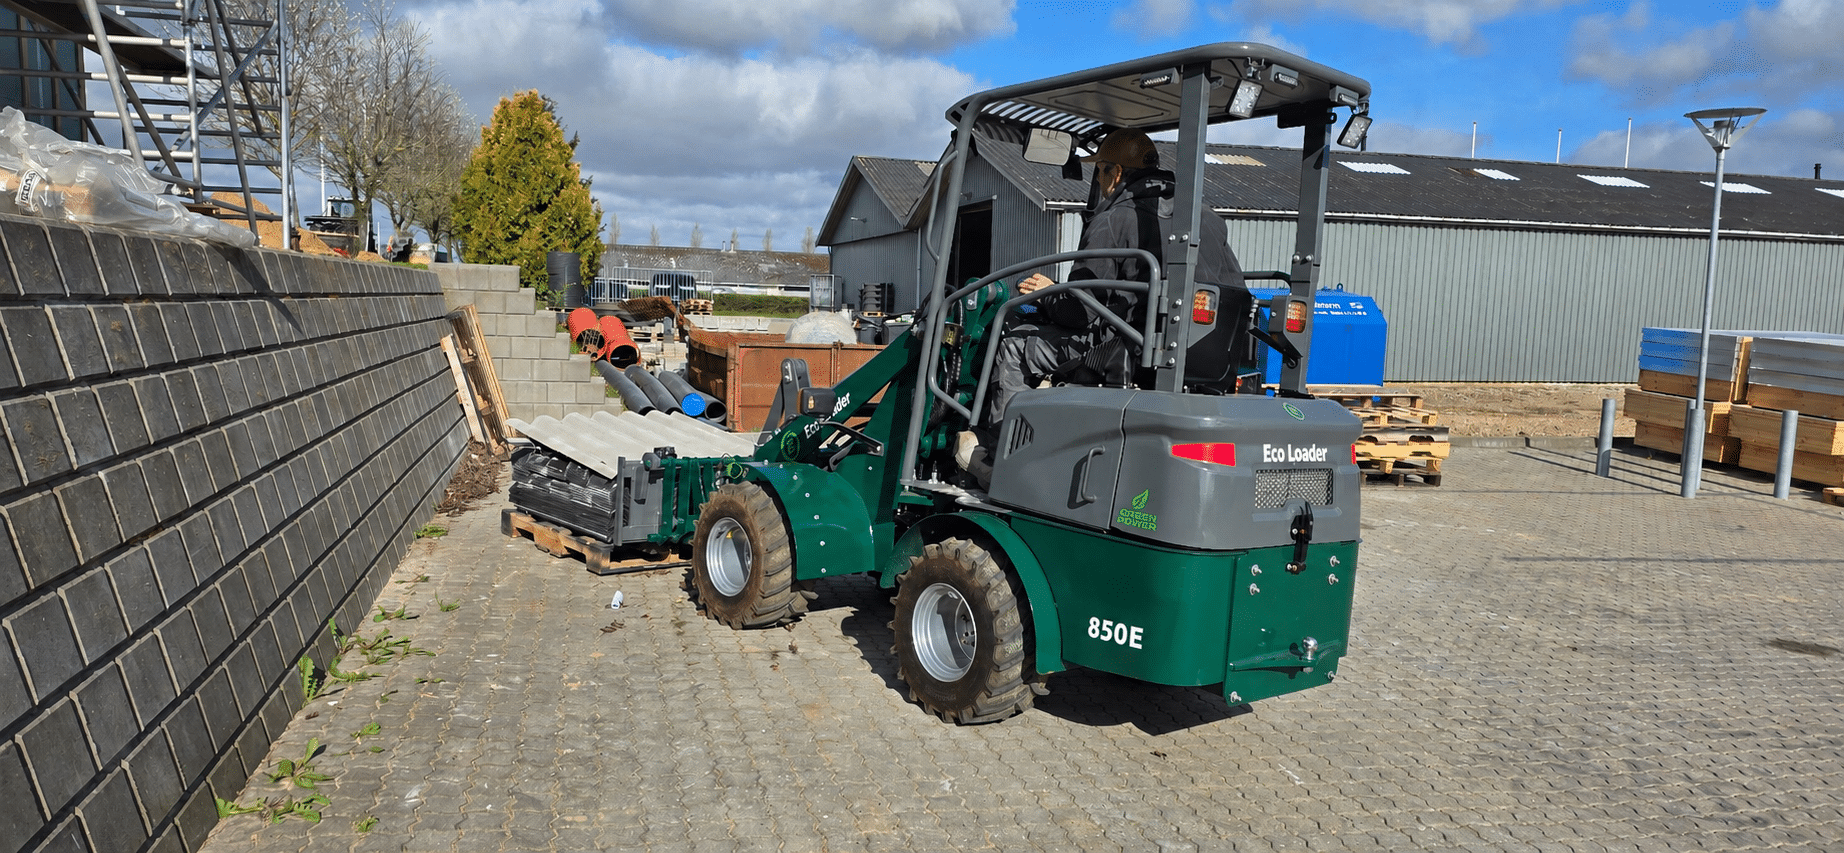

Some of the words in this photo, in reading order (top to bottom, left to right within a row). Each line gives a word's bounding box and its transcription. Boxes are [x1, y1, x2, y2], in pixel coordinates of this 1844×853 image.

[804, 421, 820, 439] Eco
[1263, 444, 1285, 463] Eco
[1287, 444, 1328, 463] Loader
[1116, 516, 1157, 532] POWER
[1119, 508, 1157, 523] GREEN
[1087, 616, 1144, 650] 850E
